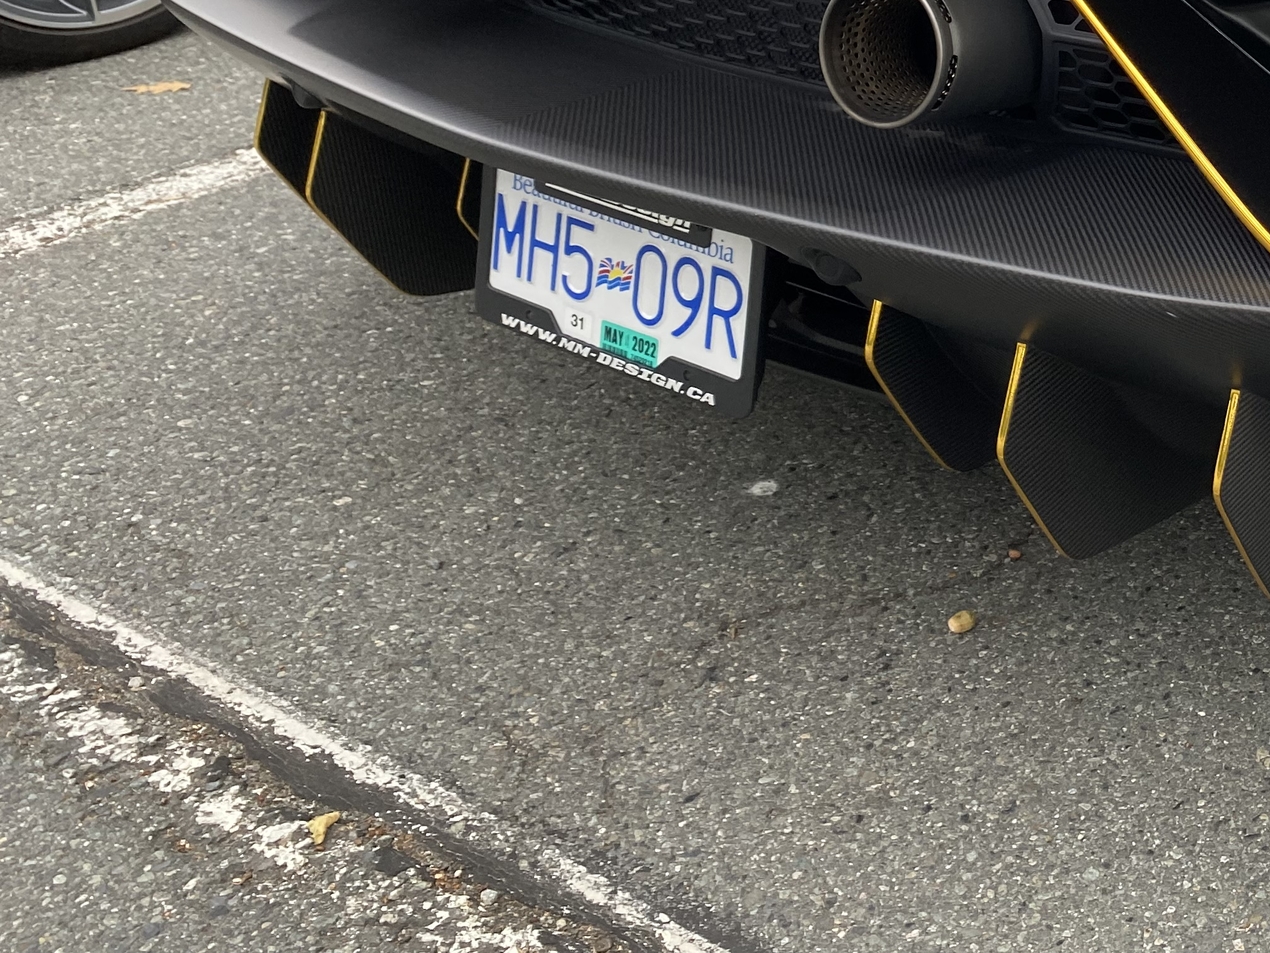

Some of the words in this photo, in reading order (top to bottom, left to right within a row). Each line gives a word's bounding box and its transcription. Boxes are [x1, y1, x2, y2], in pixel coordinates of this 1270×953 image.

[492, 192, 594, 301] MH5
[632, 244, 744, 359] 09R
[571, 314, 584, 330] 31
[604, 325, 624, 346] MAY
[632, 336, 657, 358] 2022
[500, 313, 716, 406] WWW.MM-DESIGN.CA
